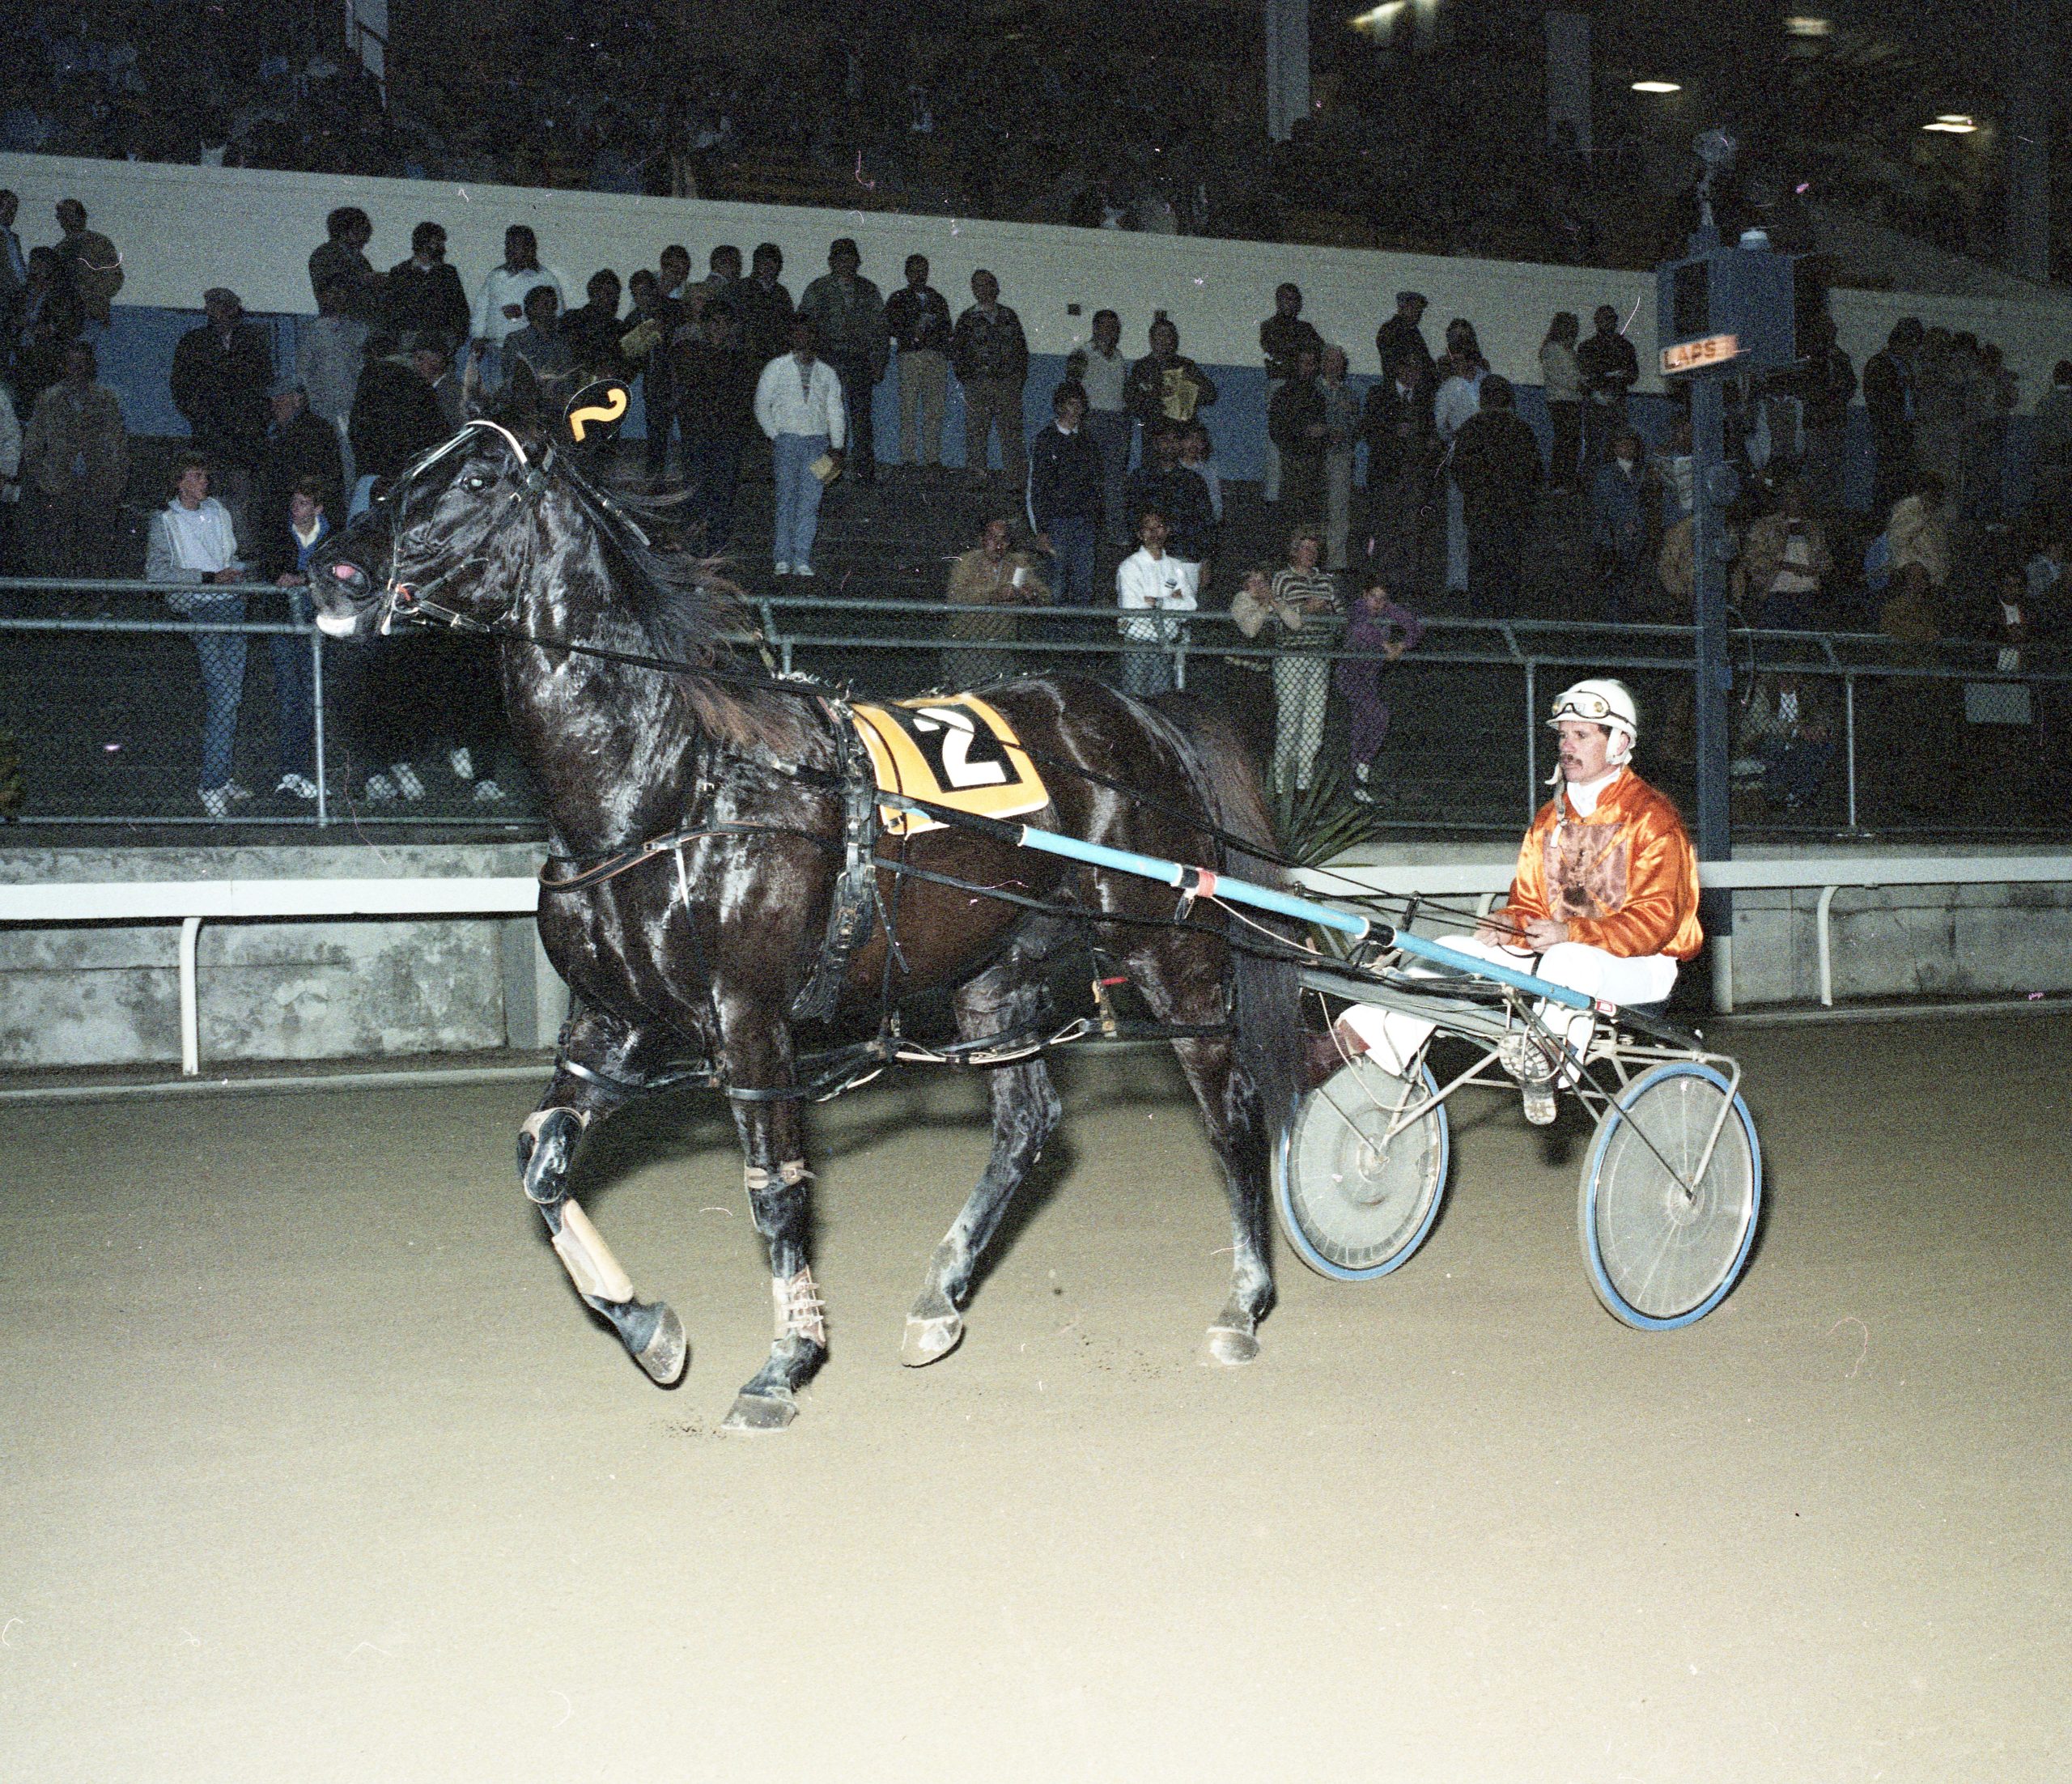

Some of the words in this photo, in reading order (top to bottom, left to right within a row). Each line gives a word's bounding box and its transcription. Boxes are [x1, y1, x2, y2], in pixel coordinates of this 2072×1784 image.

[1663, 338, 1717, 370] LAPS
[569, 388, 627, 442] 2
[912, 707, 1007, 788] 2
